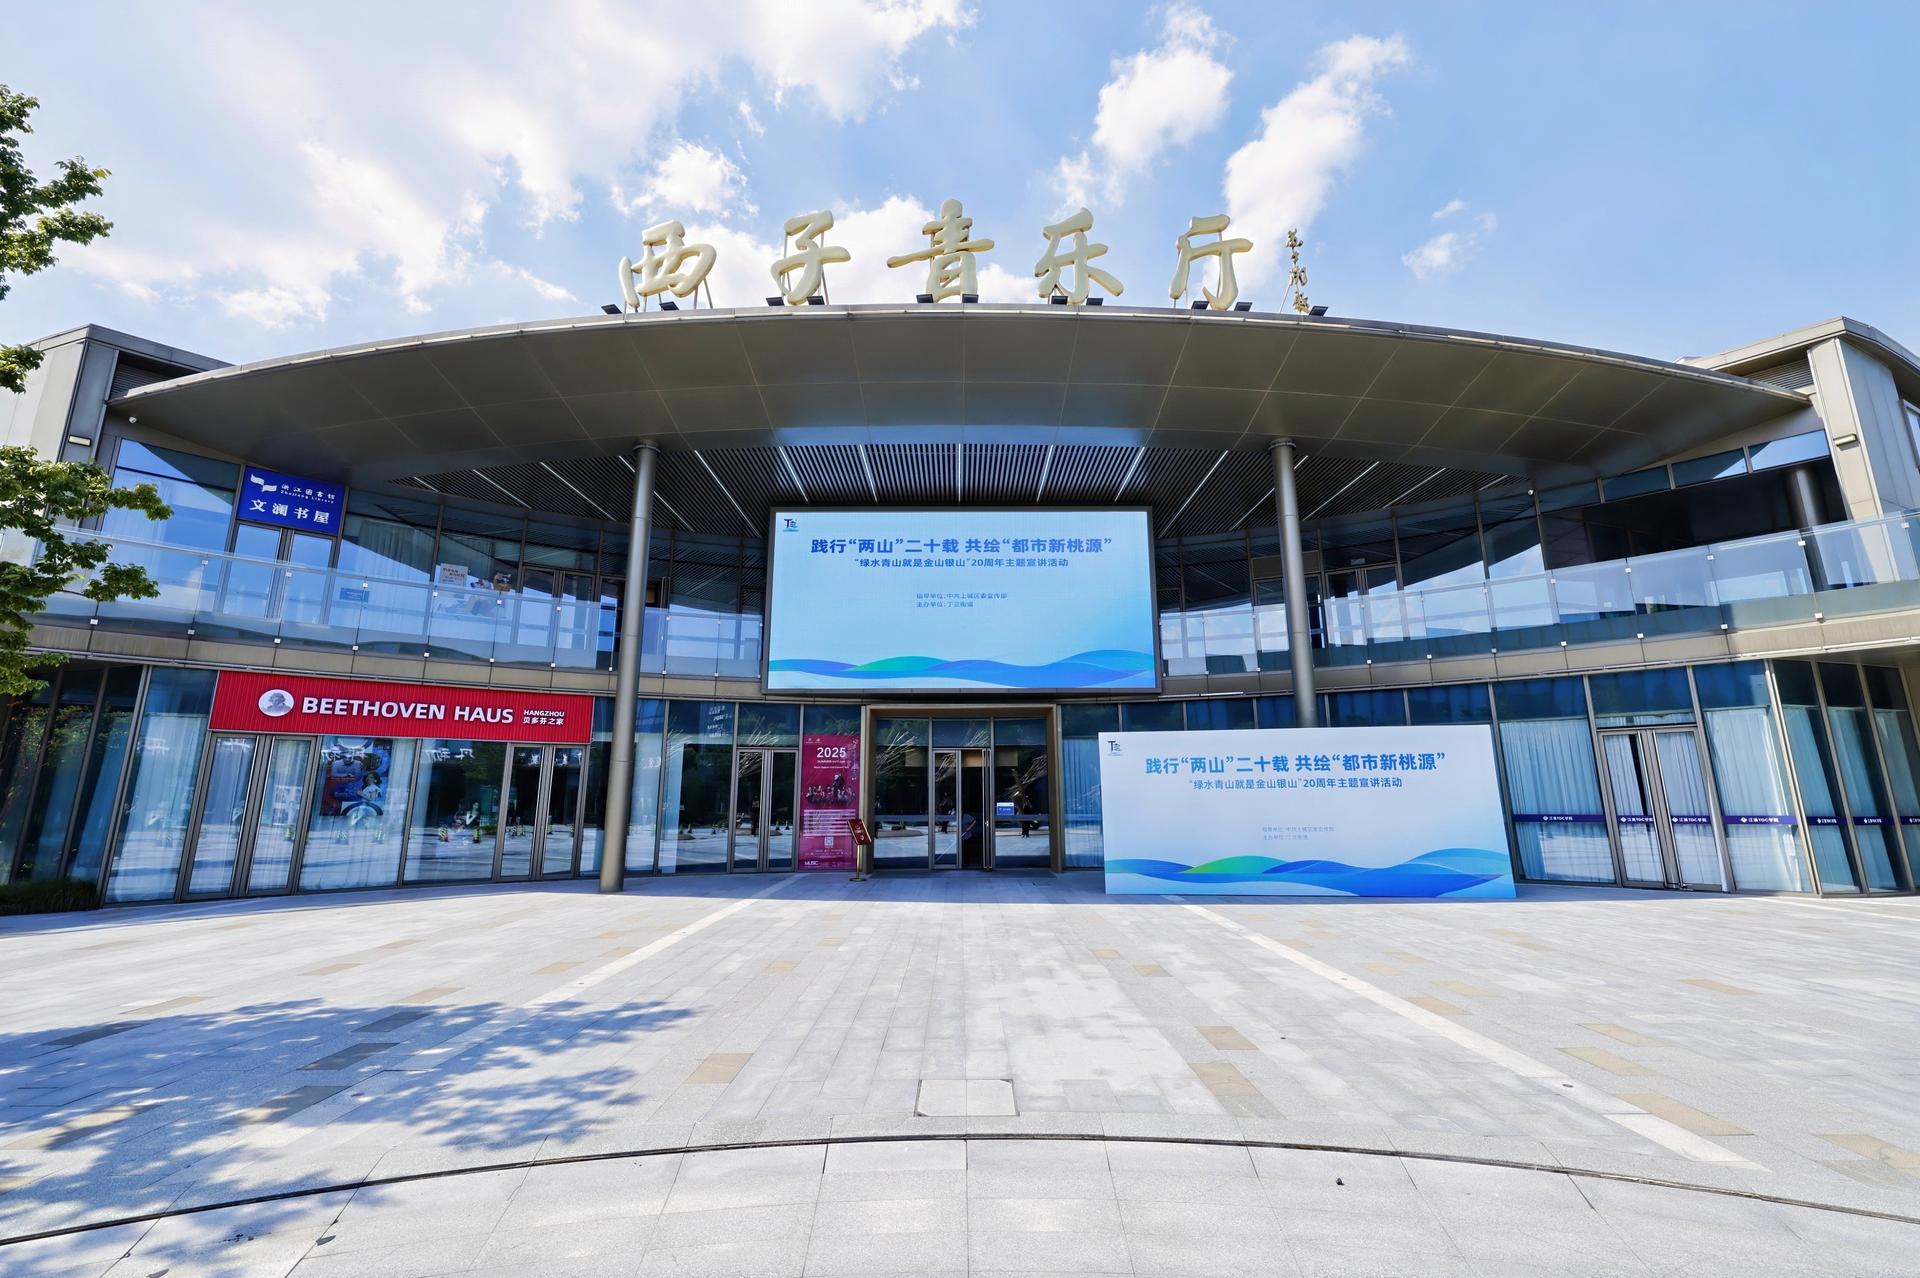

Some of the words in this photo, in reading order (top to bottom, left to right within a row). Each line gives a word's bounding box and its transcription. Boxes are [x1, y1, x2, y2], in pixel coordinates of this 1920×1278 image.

[249, 499, 330, 524] 文澜书屋
[811, 538, 959, 554] 践行“两山”二十载
[965, 537, 1112, 554] 共绘“都市新桃源”
[302, 696, 445, 720] BEETHOVEN
[454, 705, 514, 724] HAUS
[523, 709, 565, 717] HANGZHOU
[523, 716, 564, 725] 贝多芬之家
[816, 746, 847, 758] 2025
[1145, 755, 1290, 774] 践行“两山”二十载
[1295, 752, 1446, 772] 共绘“都市新桃源”
